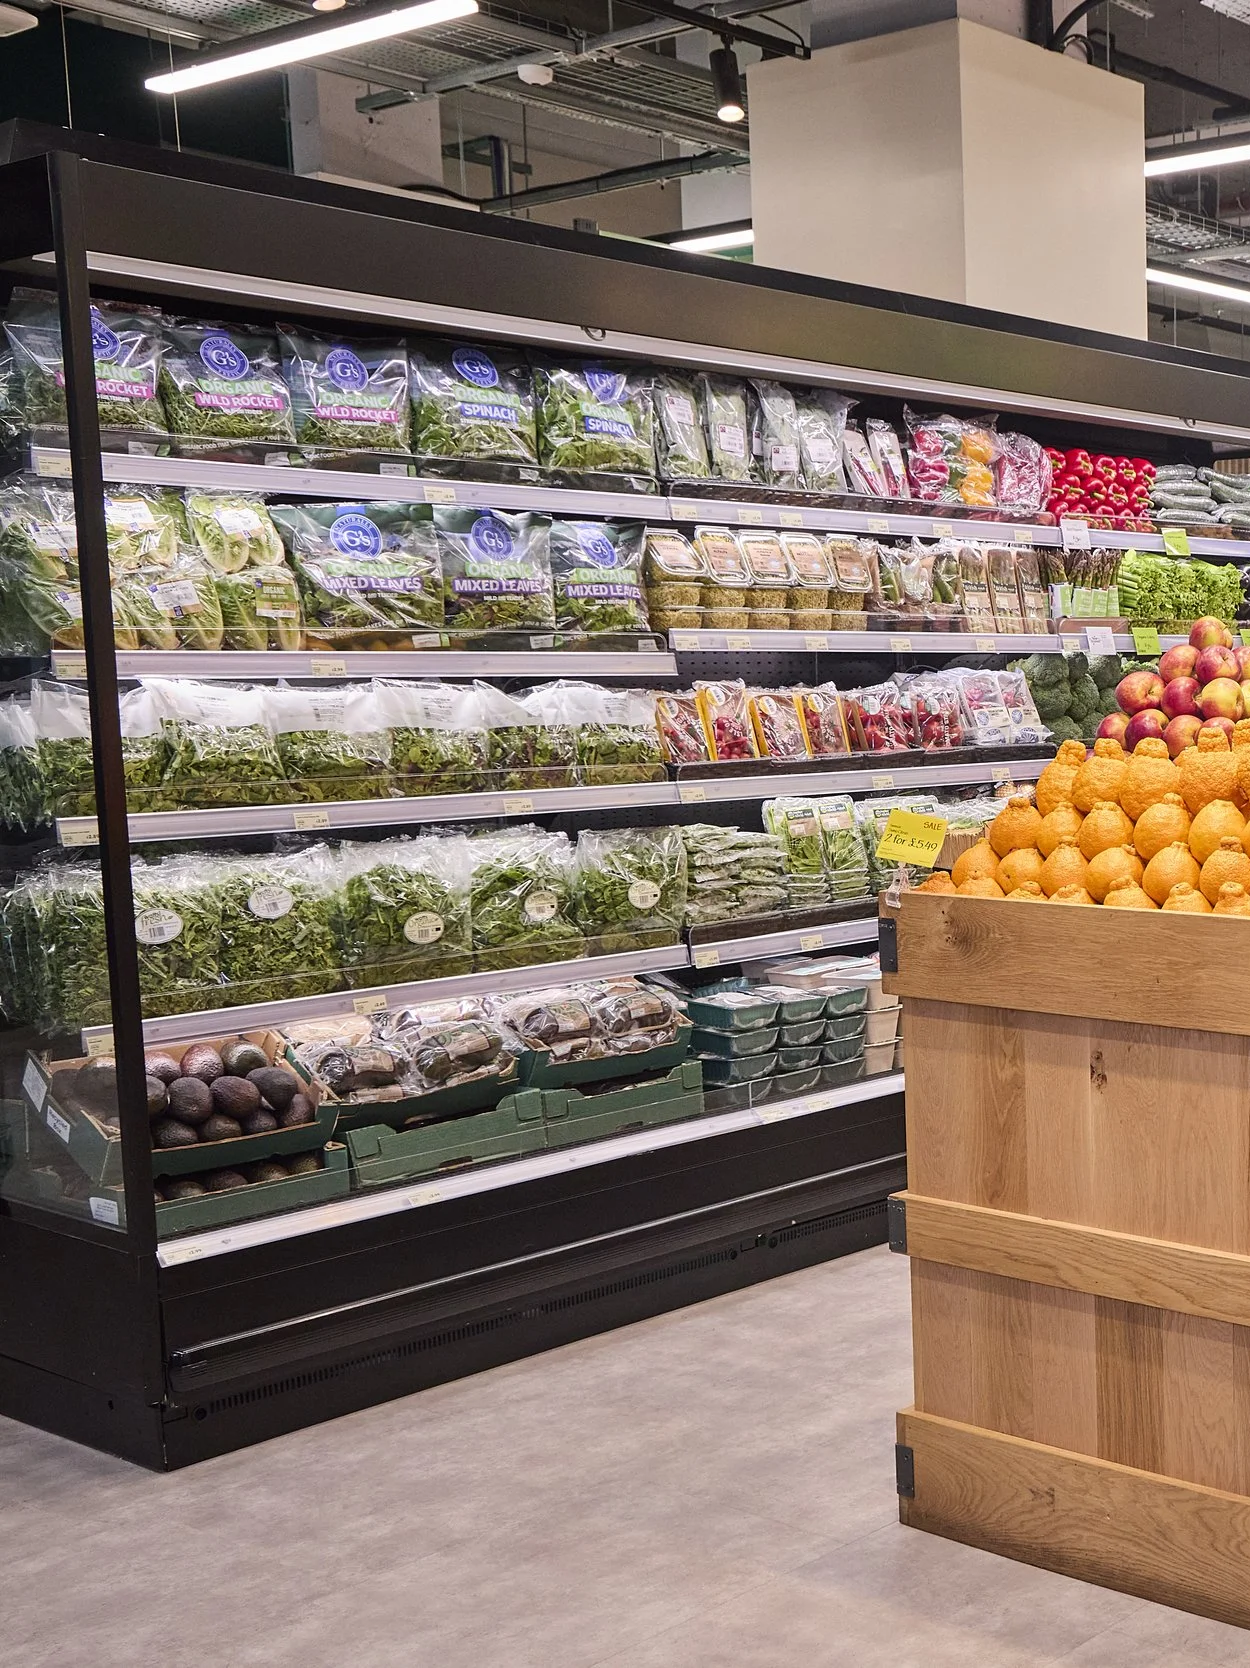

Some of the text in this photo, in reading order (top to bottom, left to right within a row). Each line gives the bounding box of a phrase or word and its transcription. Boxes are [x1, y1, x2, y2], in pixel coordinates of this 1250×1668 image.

[211, 350, 238, 367] G's
[95, 362, 140, 382] GANIC
[335, 362, 360, 379] G's
[463, 359, 490, 376] G's
[97, 379, 149, 398] ROCKET
[202, 379, 272, 395] ORGANIC
[197, 394, 282, 409] WILD ROCKET
[321, 391, 388, 408] ORGANIC
[318, 407, 397, 421] WILD ROCKET
[464, 403, 517, 420] SPINACH
[588, 418, 632, 436] SPINACH
[341, 530, 371, 547] G's
[483, 529, 504, 548] G's
[590, 538, 610, 556] G's
[329, 563, 408, 577] ORGANIC
[580, 569, 636, 583] ORGANIC
[324, 577, 422, 591] MIXED LEAVES
[455, 579, 542, 593] MIXED LEAVES
[568, 584, 641, 598] MIXED LEAVES
[923, 821, 943, 831] SALE
[884, 833, 893, 843] 2
[893, 834, 906, 845] for
